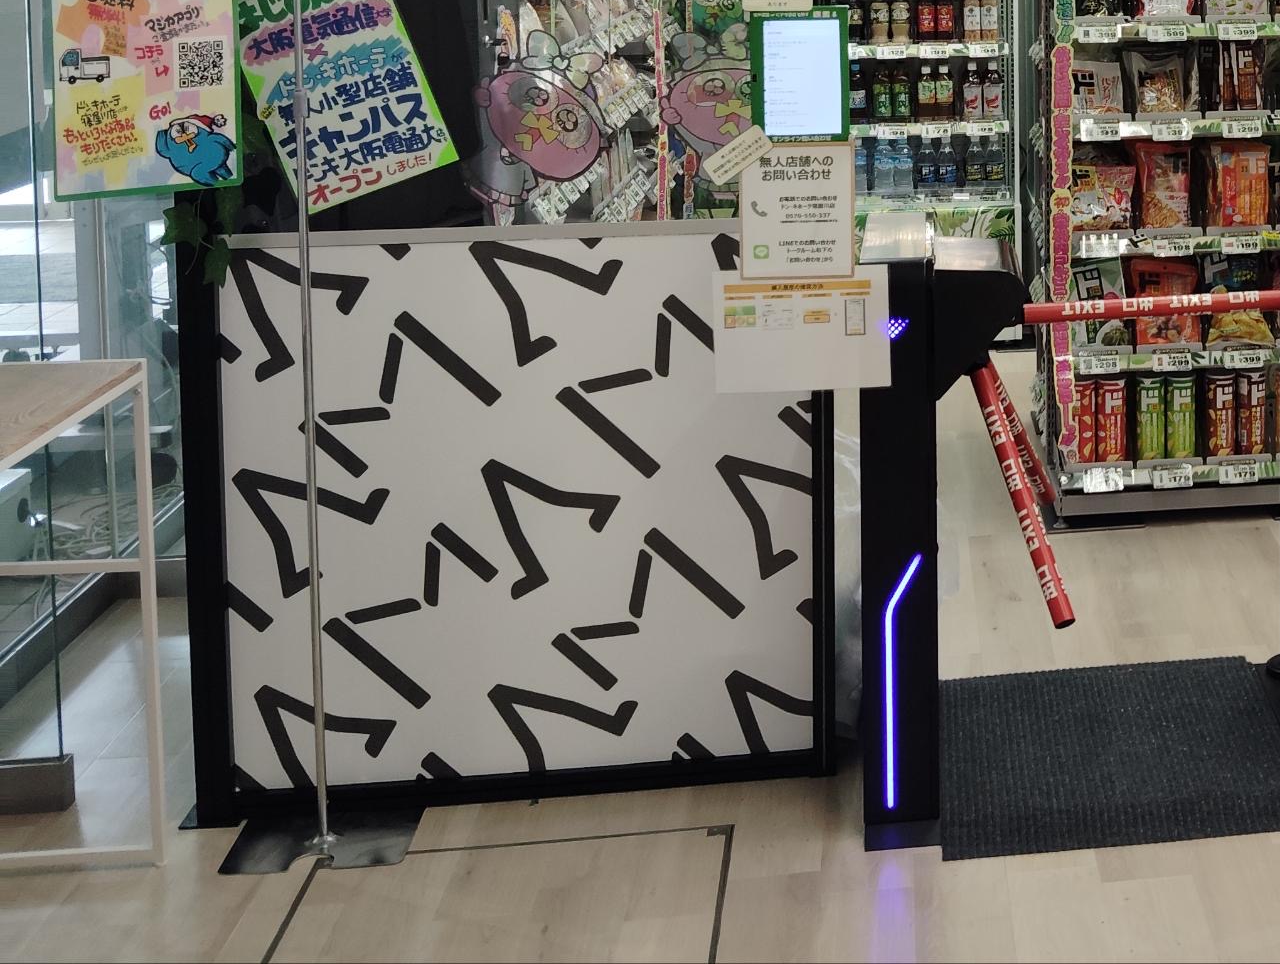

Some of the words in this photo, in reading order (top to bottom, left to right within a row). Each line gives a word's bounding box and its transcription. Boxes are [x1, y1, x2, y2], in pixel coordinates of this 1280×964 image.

[145, 4, 201, 32] マジカアプリ
[248, 3, 393, 60] 大阪電気通信大学
[279, 93, 428, 159] キャンパス
[760, 156, 834, 168] 無人店舗への
[761, 169, 832, 181] お問い合わせ
[1062, 300, 1105, 316] EXIT
